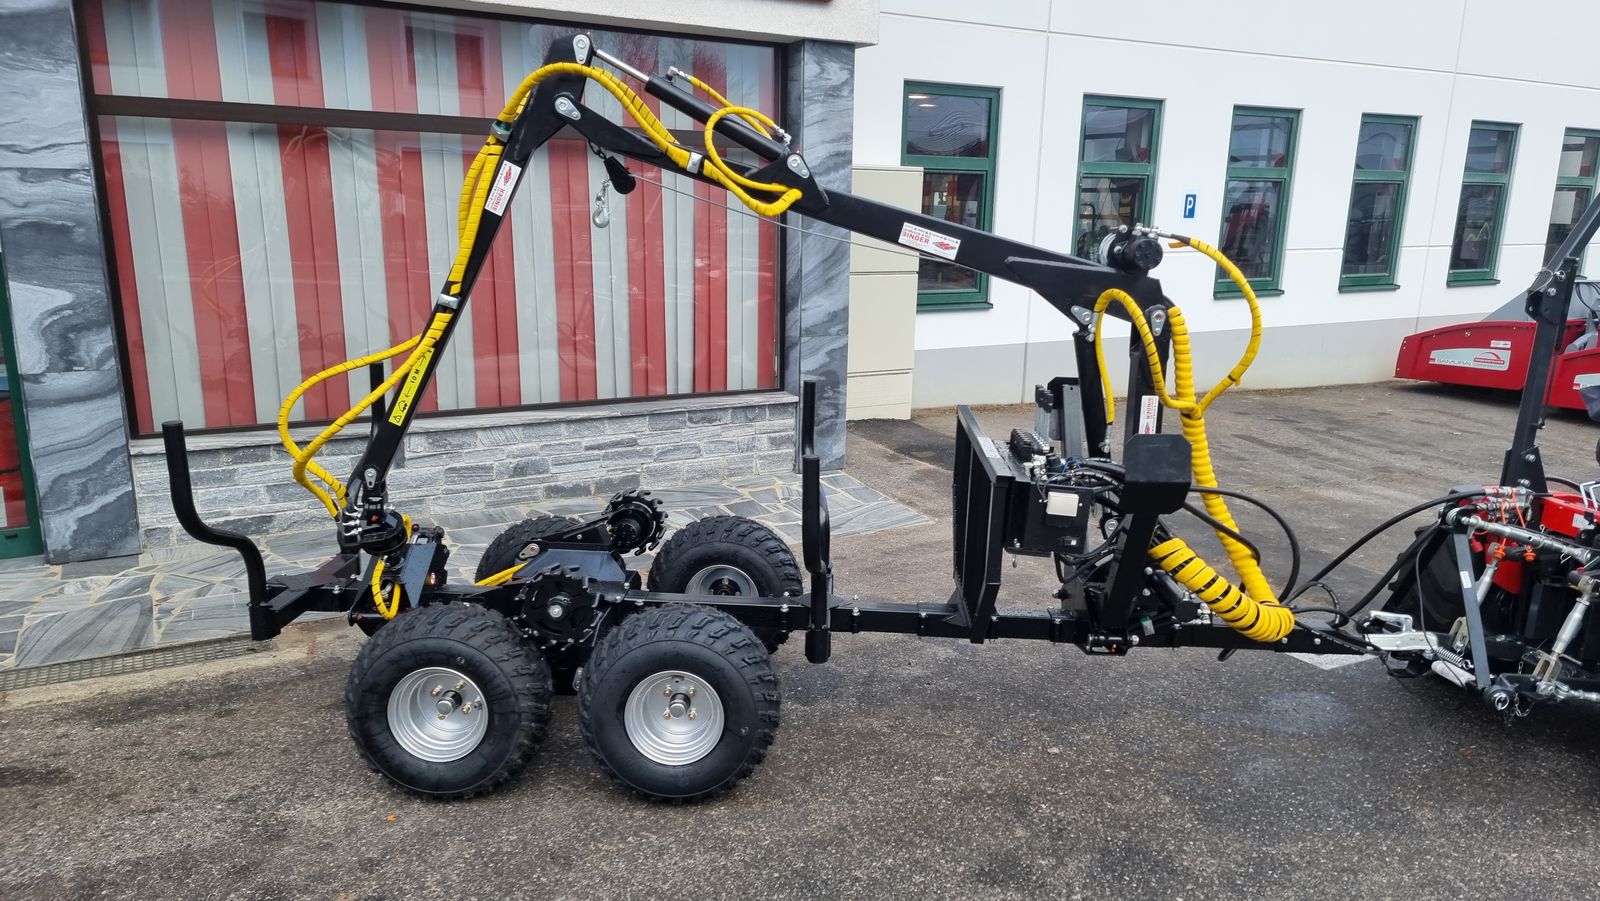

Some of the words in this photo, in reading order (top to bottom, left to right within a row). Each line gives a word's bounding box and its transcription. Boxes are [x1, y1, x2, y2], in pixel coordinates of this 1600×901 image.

[492, 188, 505, 211] BINDER
[1185, 196, 1194, 217] P
[902, 230, 930, 245] BINDER
